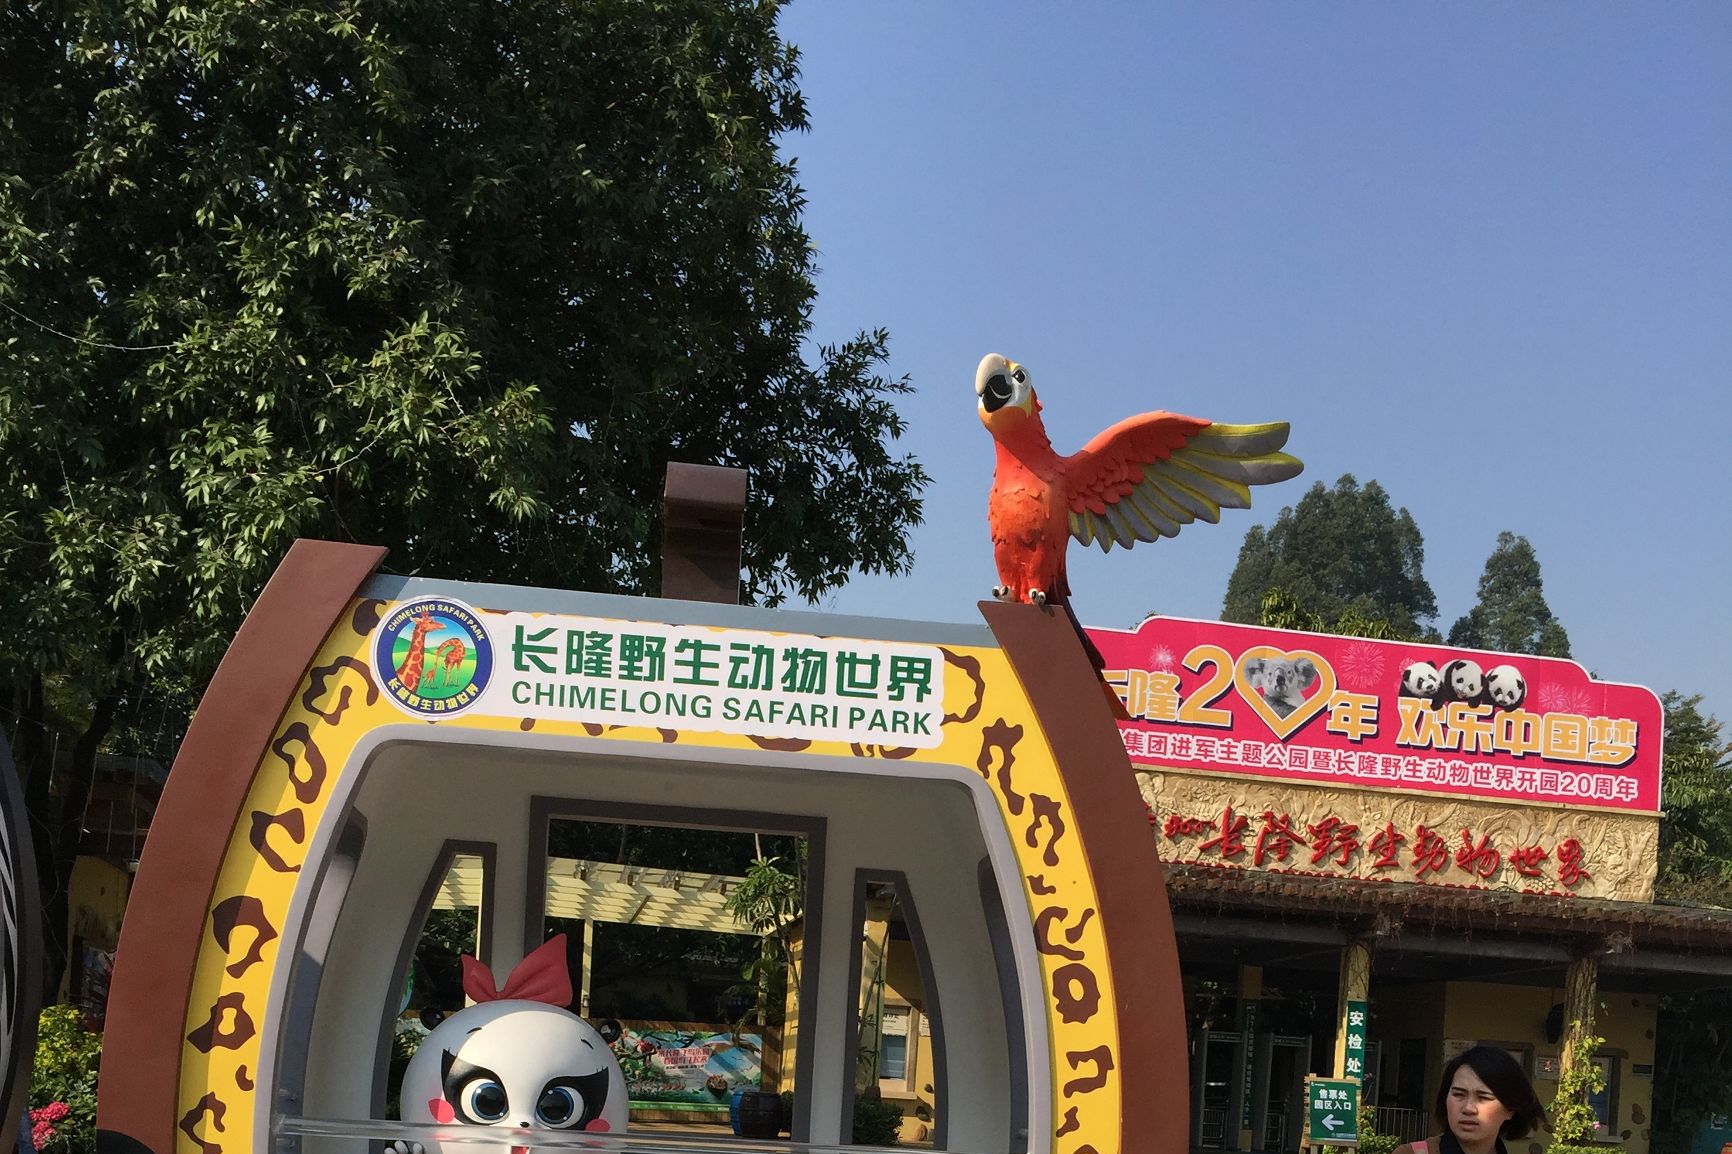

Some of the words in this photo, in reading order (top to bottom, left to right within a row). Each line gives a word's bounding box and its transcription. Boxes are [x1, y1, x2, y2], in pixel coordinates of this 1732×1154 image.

[388, 604, 436, 632] CHIMELONG
[437, 604, 469, 622] SAFARI
[466, 619, 485, 641] PARK
[512, 625, 932, 703] 长隆野生动物世界
[512, 680, 712, 719] CHIMELONG
[722, 696, 839, 729] SAFARI
[849, 706, 932, 736] PARK
[1396, 696, 1637, 765] 欢乐中国梦
[1346, 1011, 1364, 1073] 安检处
[1319, 1088, 1348, 1100] 售票处
